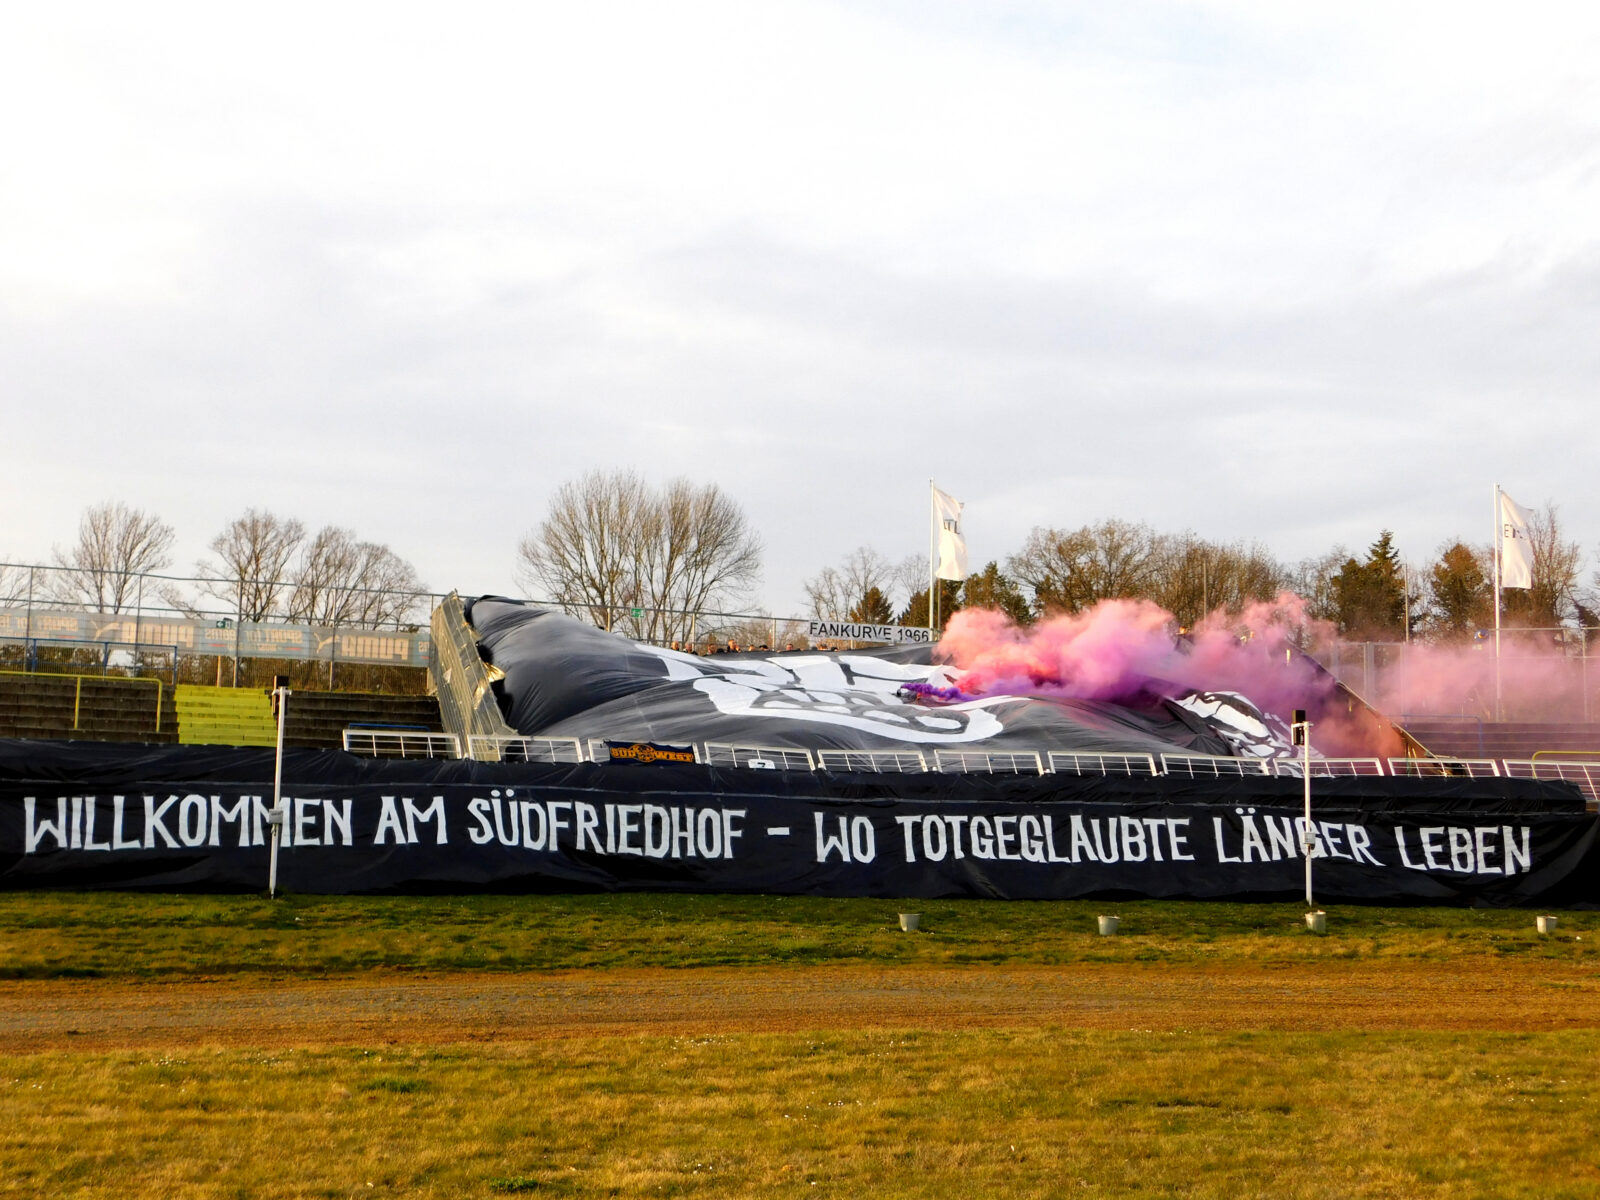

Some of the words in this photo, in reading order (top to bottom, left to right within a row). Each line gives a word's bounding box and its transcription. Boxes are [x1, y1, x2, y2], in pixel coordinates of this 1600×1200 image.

[809, 621, 892, 640] FANKURVE
[897, 629, 929, 642] 1966
[24, 794, 353, 853] WILLKOMMEN
[373, 795, 448, 846] AM
[467, 788, 746, 859] SÜDFRIEDHOF
[814, 811, 876, 864] WO
[896, 814, 1195, 864] TOTGEGLAUBTE
[1212, 807, 1387, 867] LÄNGER
[1394, 825, 1531, 876] LEBEN
